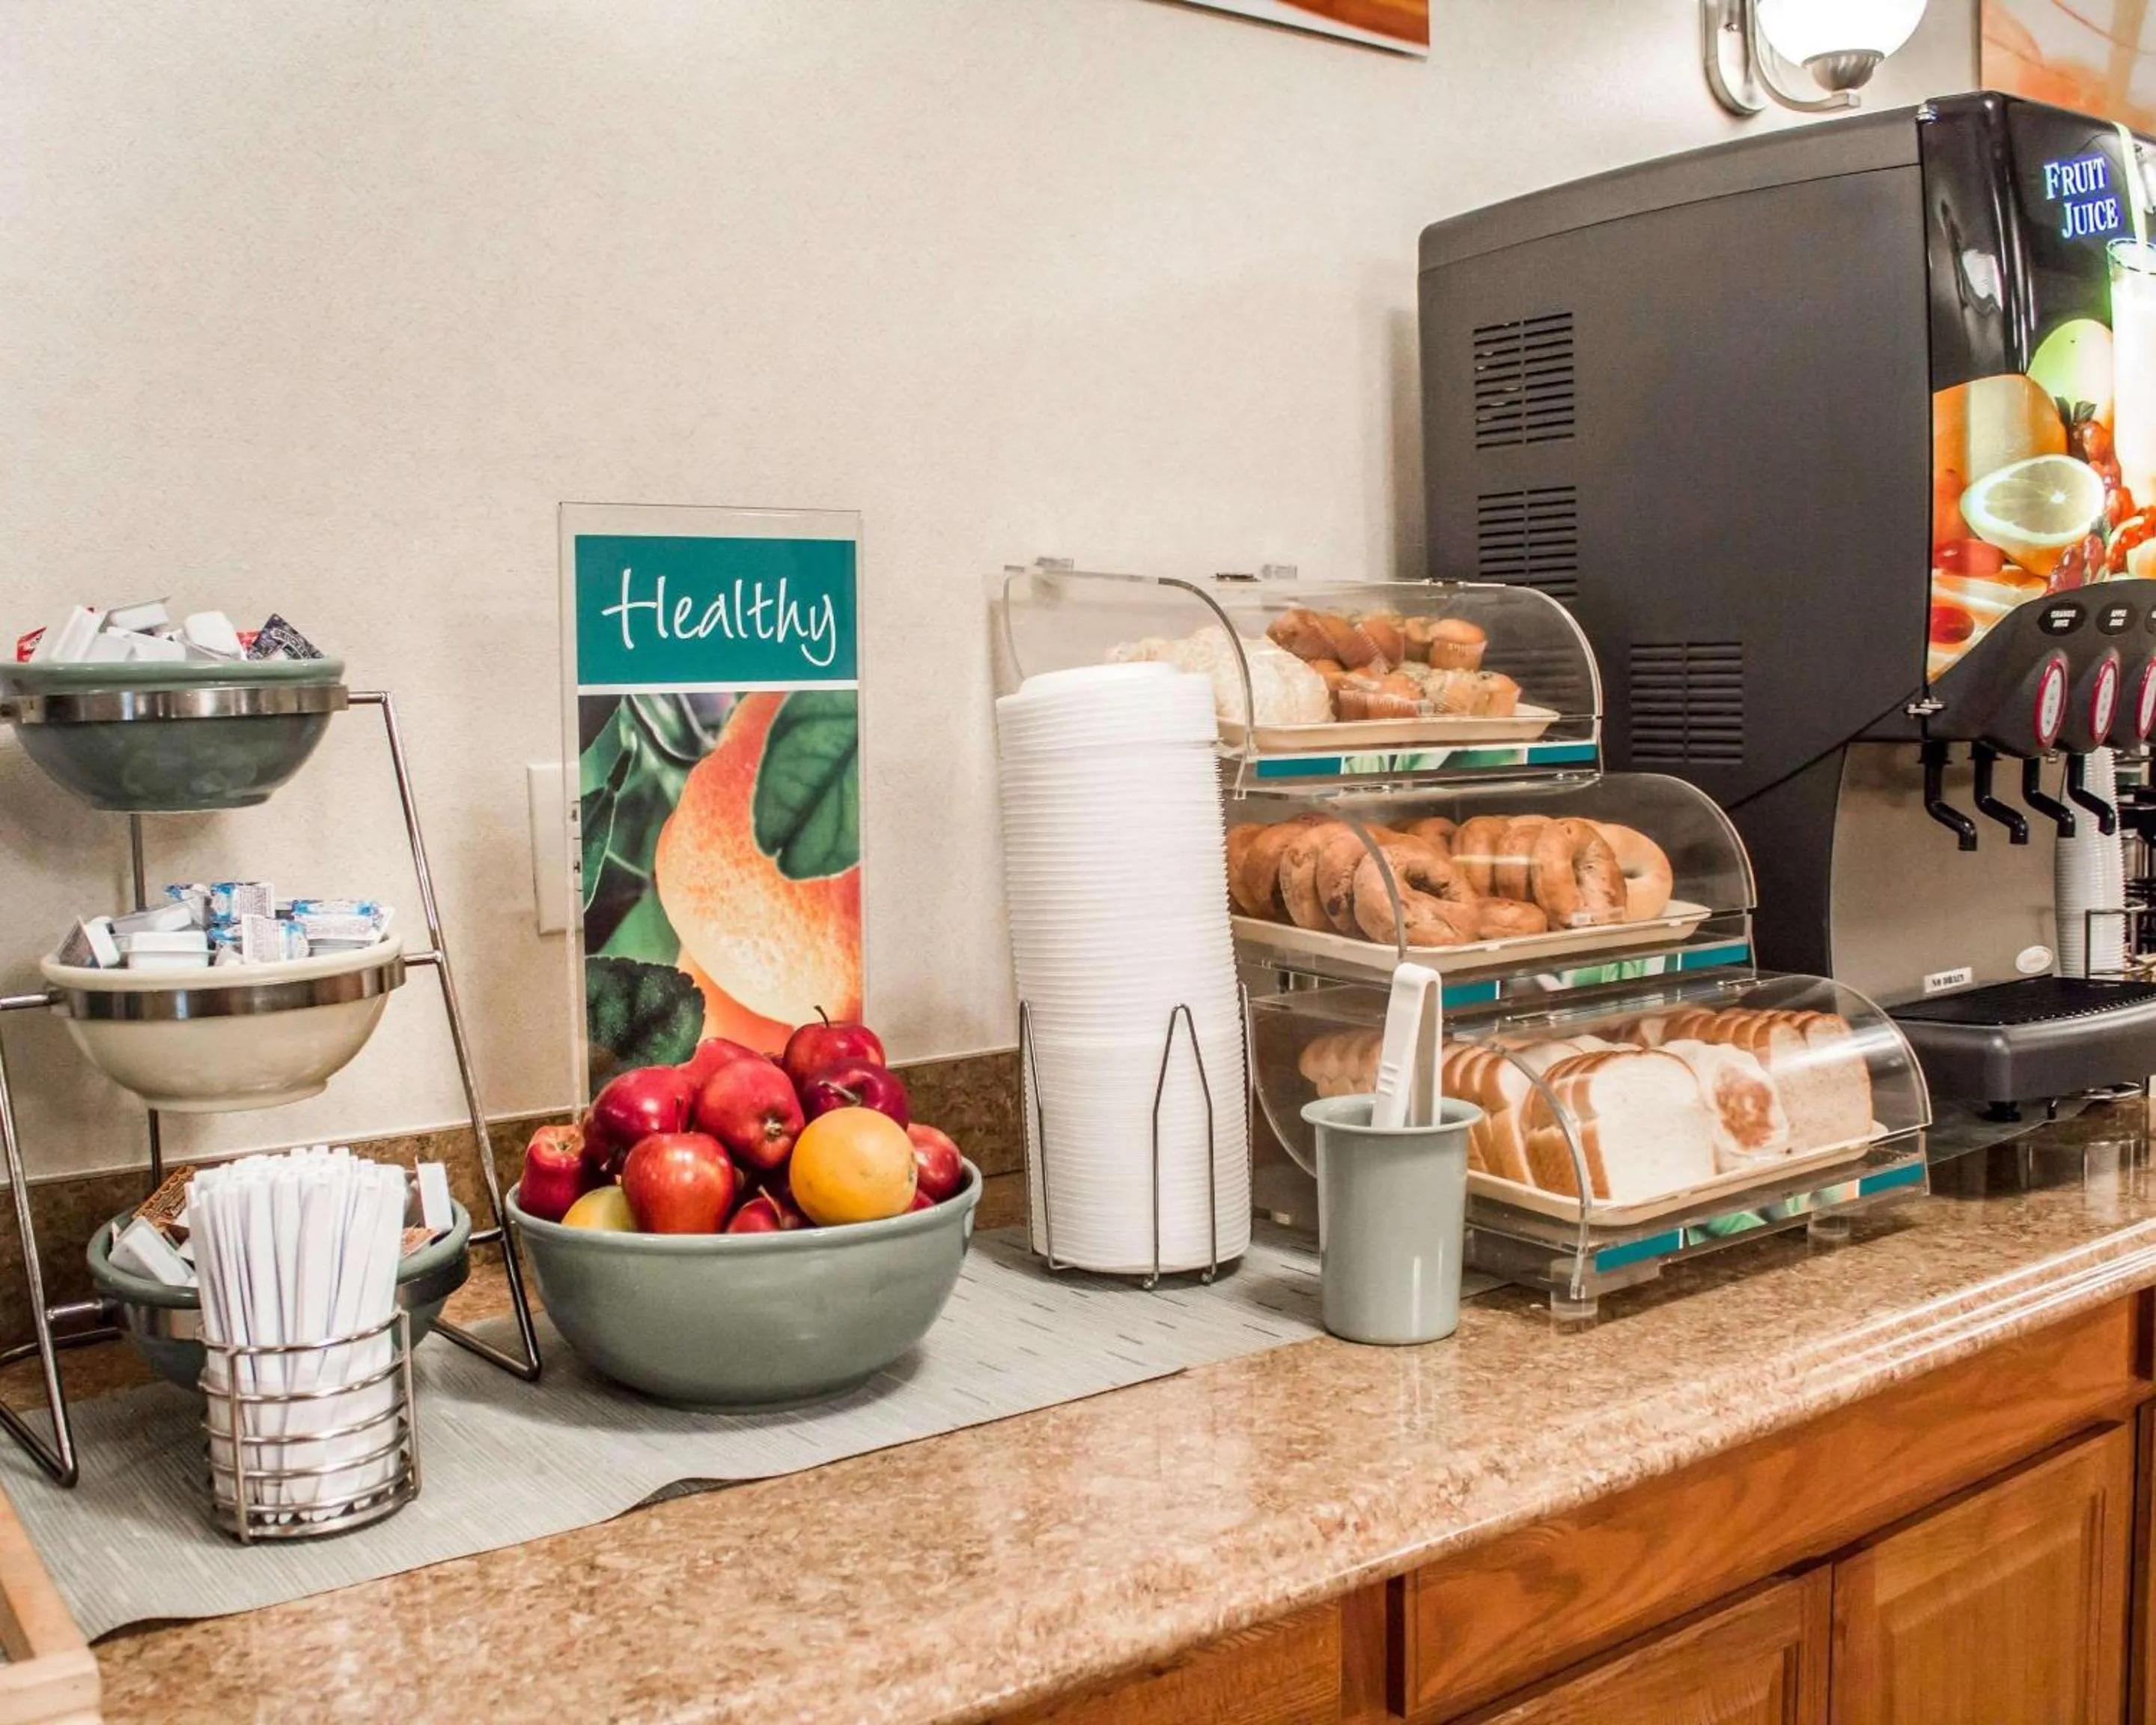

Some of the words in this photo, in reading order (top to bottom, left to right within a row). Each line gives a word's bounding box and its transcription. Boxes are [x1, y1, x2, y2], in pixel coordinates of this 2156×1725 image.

[2044, 157, 2105, 200] FRUIT
[2062, 198, 2119, 239] JUICE
[601, 568, 836, 666] Healthy
